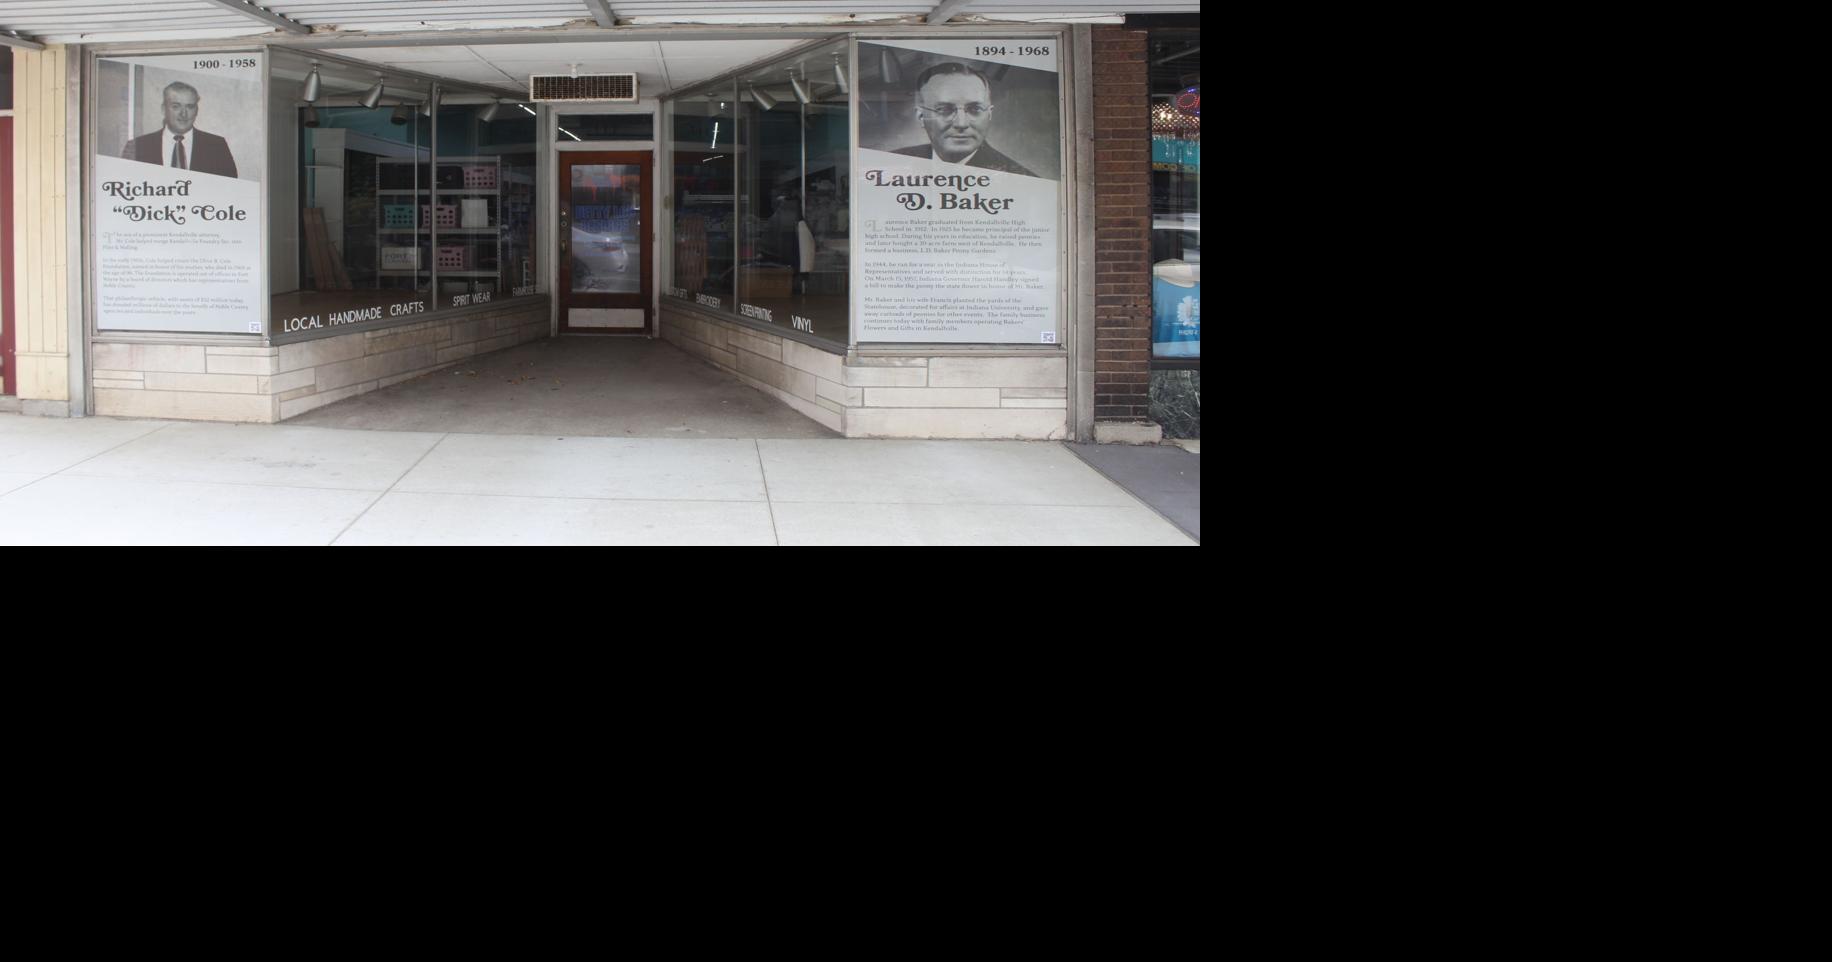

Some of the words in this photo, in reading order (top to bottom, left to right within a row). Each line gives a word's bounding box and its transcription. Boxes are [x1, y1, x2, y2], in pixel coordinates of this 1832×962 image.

[976, 46, 1006, 56] 1894
[1018, 46, 1050, 56] 1968
[193, 60, 220, 69] 1900
[230, 58, 256, 68] 1958
[865, 170, 990, 191] Laurence
[102, 180, 192, 201] Richard
[897, 192, 932, 210] D.
[939, 192, 1014, 214] Baker
[191, 205, 246, 221] Cole
[453, 294, 470, 307] SPIRIT
[472, 292, 491, 304] WEAR
[284, 316, 323, 332] LOCAL
[329, 307, 382, 326] HANDMADE
[390, 302, 424, 316] CRAFTS
[792, 315, 814, 333] VINYL
